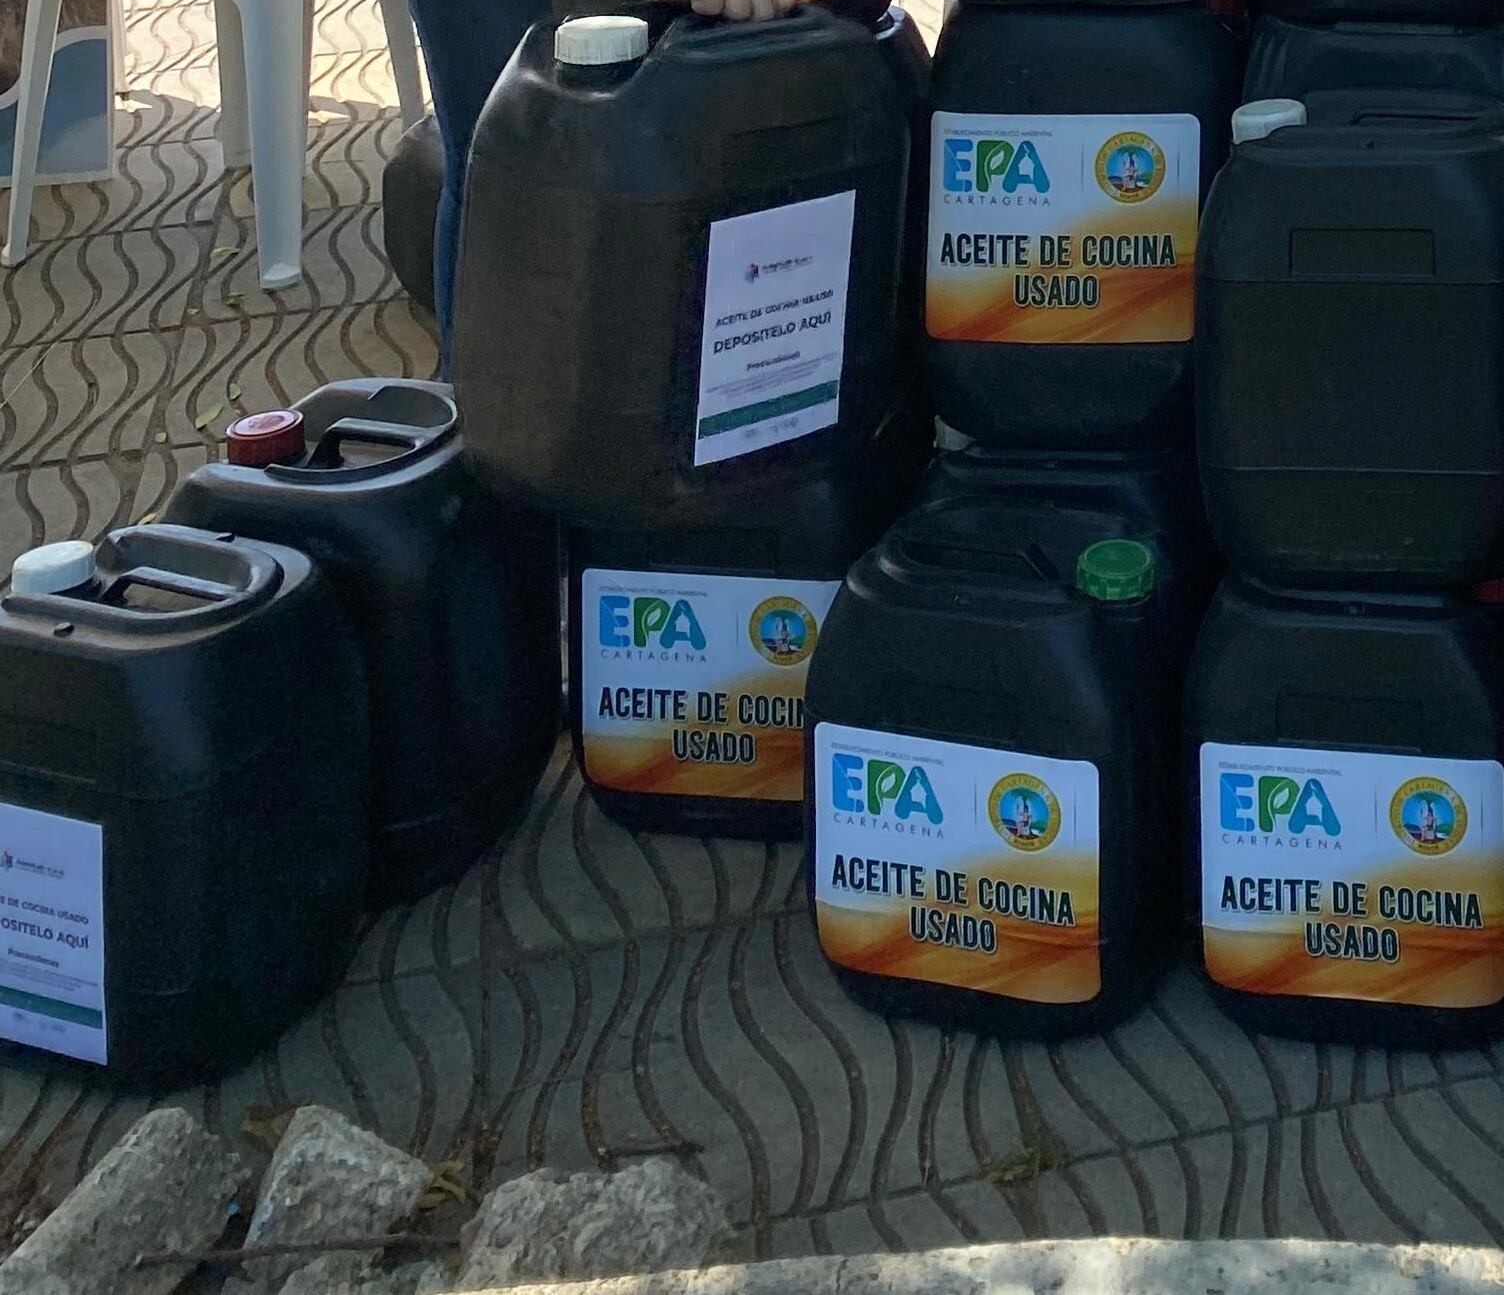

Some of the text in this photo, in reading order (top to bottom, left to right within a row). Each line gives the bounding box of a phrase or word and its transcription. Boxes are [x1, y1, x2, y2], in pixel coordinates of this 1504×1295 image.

[944, 139, 1050, 193] EPA
[944, 195, 1050, 205] CARTAGENA
[940, 233, 1175, 266] ACEITE DE COCINA
[1014, 275, 1098, 306] USADO
[599, 596, 706, 650] EPA
[599, 687, 803, 727] ACEITE DE COCI
[673, 730, 755, 761] USADO
[832, 753, 944, 824] EPA
[1220, 773, 1341, 836] EPA
[834, 814, 944, 839] CARTAGENA
[1222, 834, 1342, 850] CARTAGENA
[832, 854, 1074, 925] ACEITE DE COCINA
[1221, 876, 1483, 927] ACEITE DE COCINA
[0, 917, 88, 948] OSITELO AQUÍ
[57, 909, 88, 925] USADO
[910, 906, 995, 952] USADO
[1306, 922, 1398, 961] USADO
